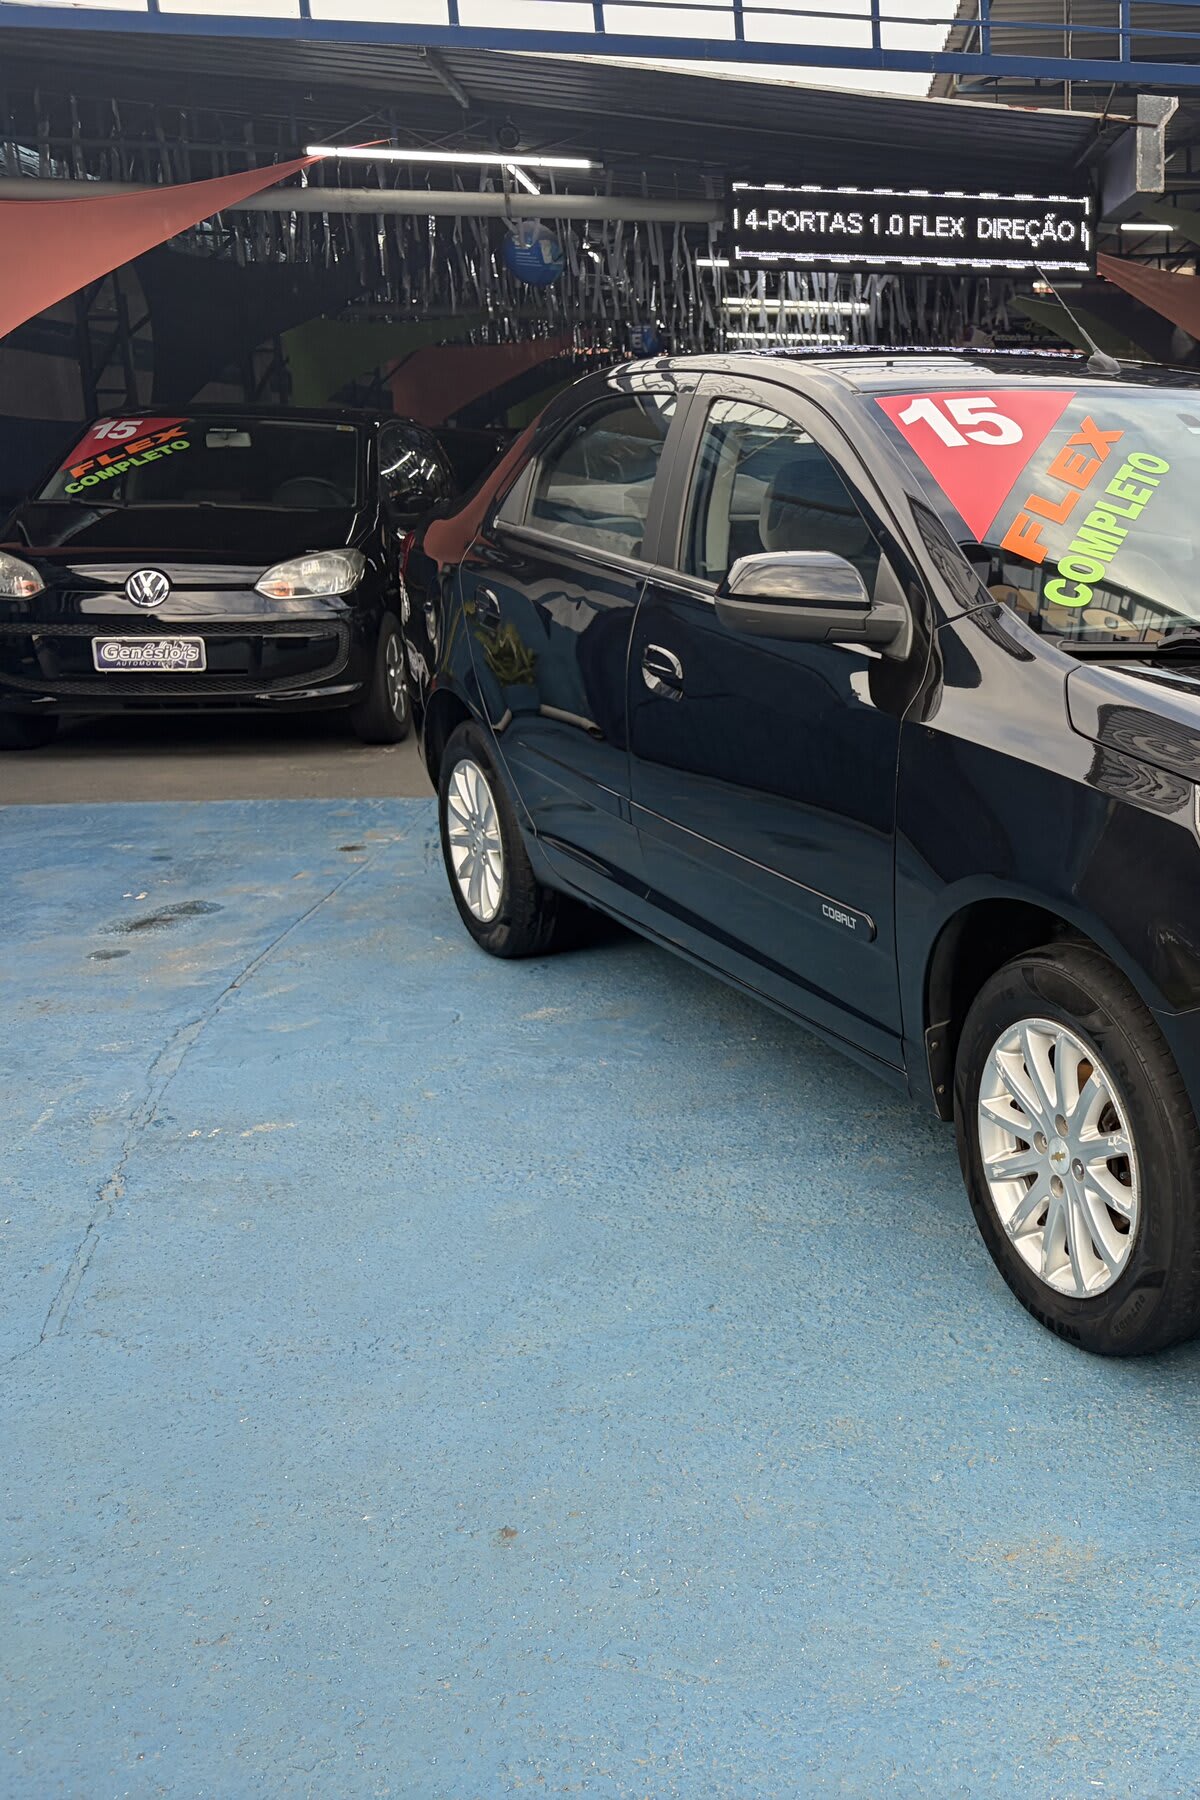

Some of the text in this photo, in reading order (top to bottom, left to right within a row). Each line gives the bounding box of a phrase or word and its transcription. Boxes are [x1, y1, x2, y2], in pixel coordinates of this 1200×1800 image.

[745, 208, 1075, 247] 4-PORTAS 1.0 FLEX DIREÇÃO
[92, 420, 144, 440] 15
[898, 397, 1024, 447] 15
[64, 440, 191, 494] COMPLETO
[70, 426, 189, 479] FLEX
[1000, 416, 1126, 564] FLEX
[1044, 452, 1170, 608] COMPLETO
[822, 903, 857, 930] COBALT
